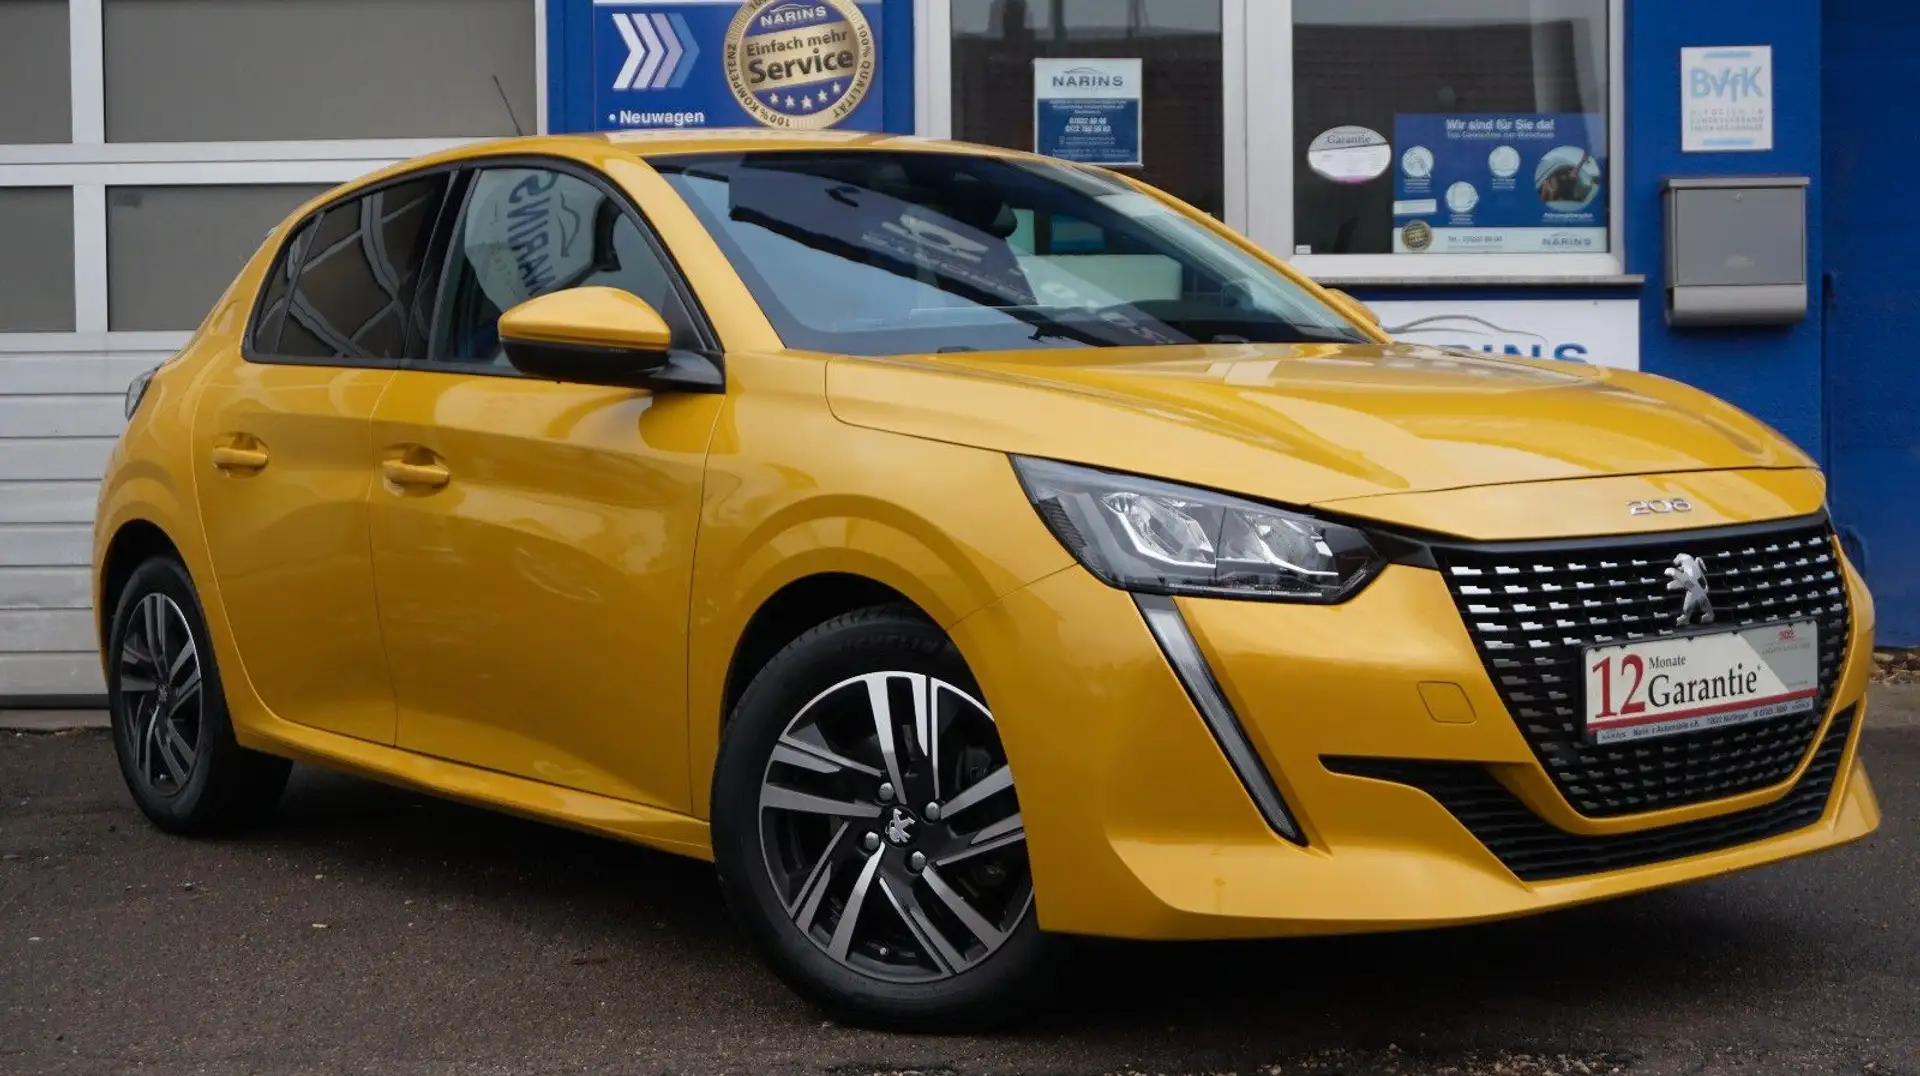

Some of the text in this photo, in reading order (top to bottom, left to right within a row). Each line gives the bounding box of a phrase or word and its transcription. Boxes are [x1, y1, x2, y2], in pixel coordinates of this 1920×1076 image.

[760, 6, 827, 27] NARINS
[746, 29, 848, 57] Einfach mehr
[748, 48, 853, 84] Service
[832, 24, 872, 119] 100% QUALITÄT
[727, 44, 790, 127] 100% KOMPETENZ
[1052, 75, 1124, 87] NARINS
[620, 111, 704, 128] Neuwagen
[1446, 118, 1555, 130] Wir sind für Sie da!
[1326, 132, 1372, 145] Garantie
[1542, 237, 1592, 246] NARINS
[1626, 497, 1692, 515] 208
[1649, 654, 1687, 669] Monate
[1592, 653, 1646, 718] 12
